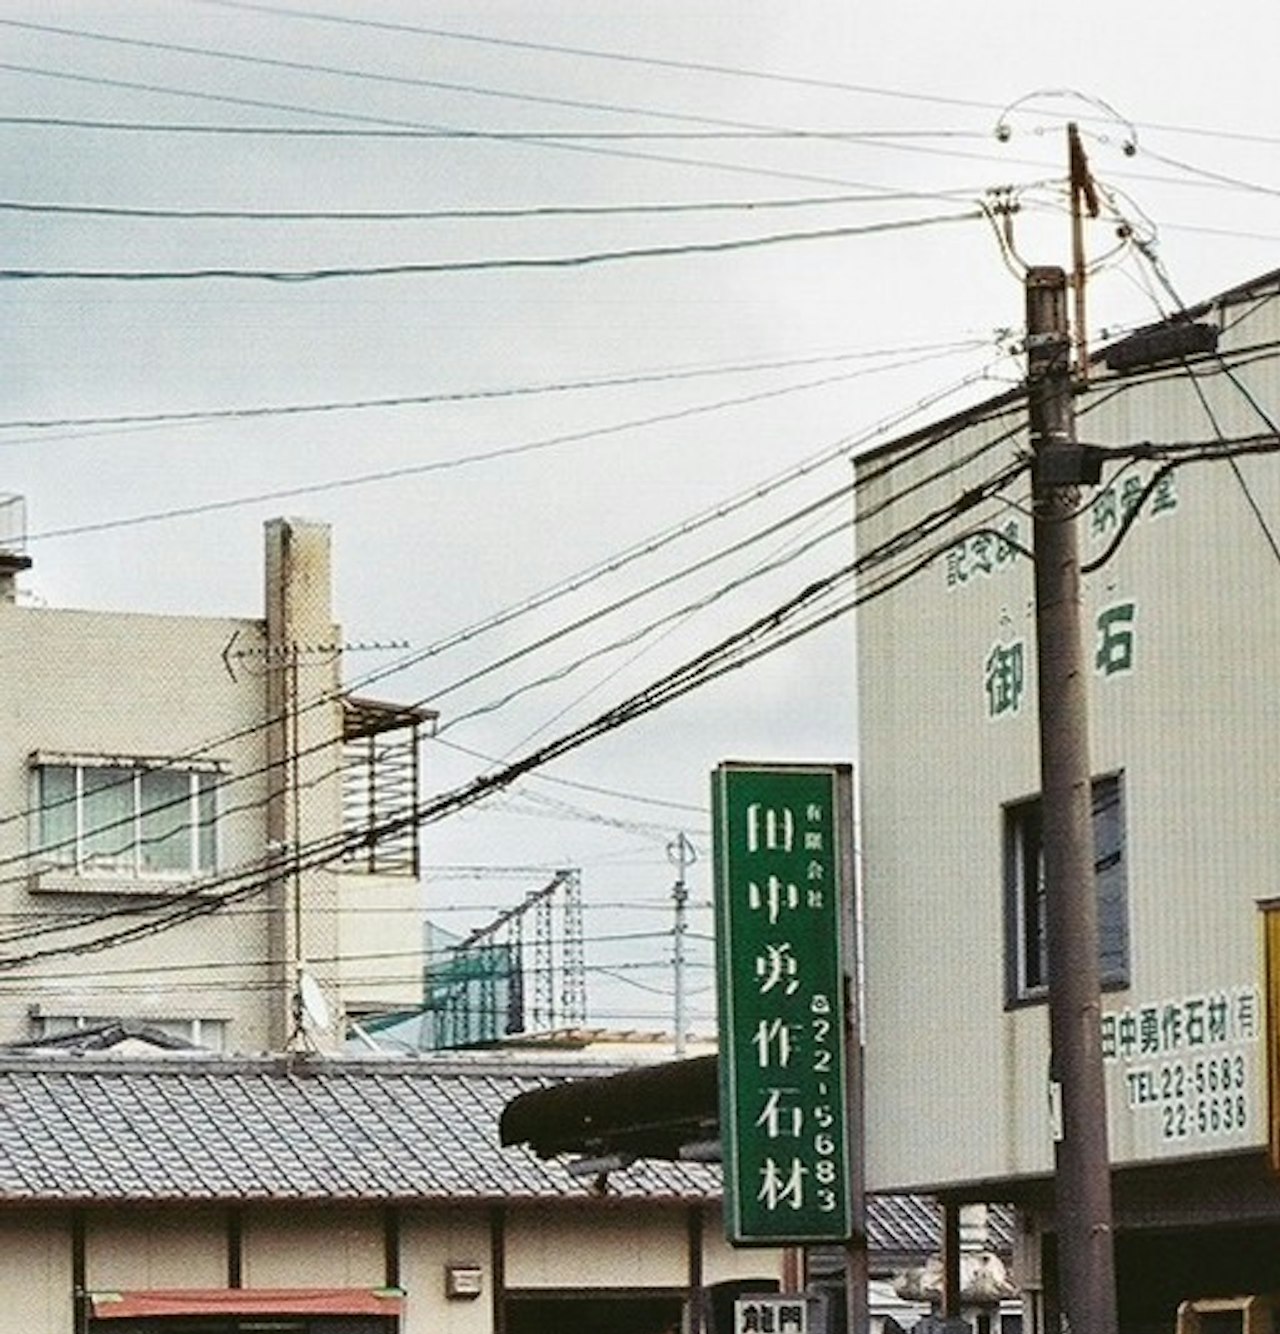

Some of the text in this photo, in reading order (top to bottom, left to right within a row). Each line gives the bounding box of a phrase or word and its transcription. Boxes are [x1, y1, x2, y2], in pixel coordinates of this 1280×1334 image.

[804, 803, 825, 909] 有限会社
[746, 802, 807, 1212] 田中勇作石材
